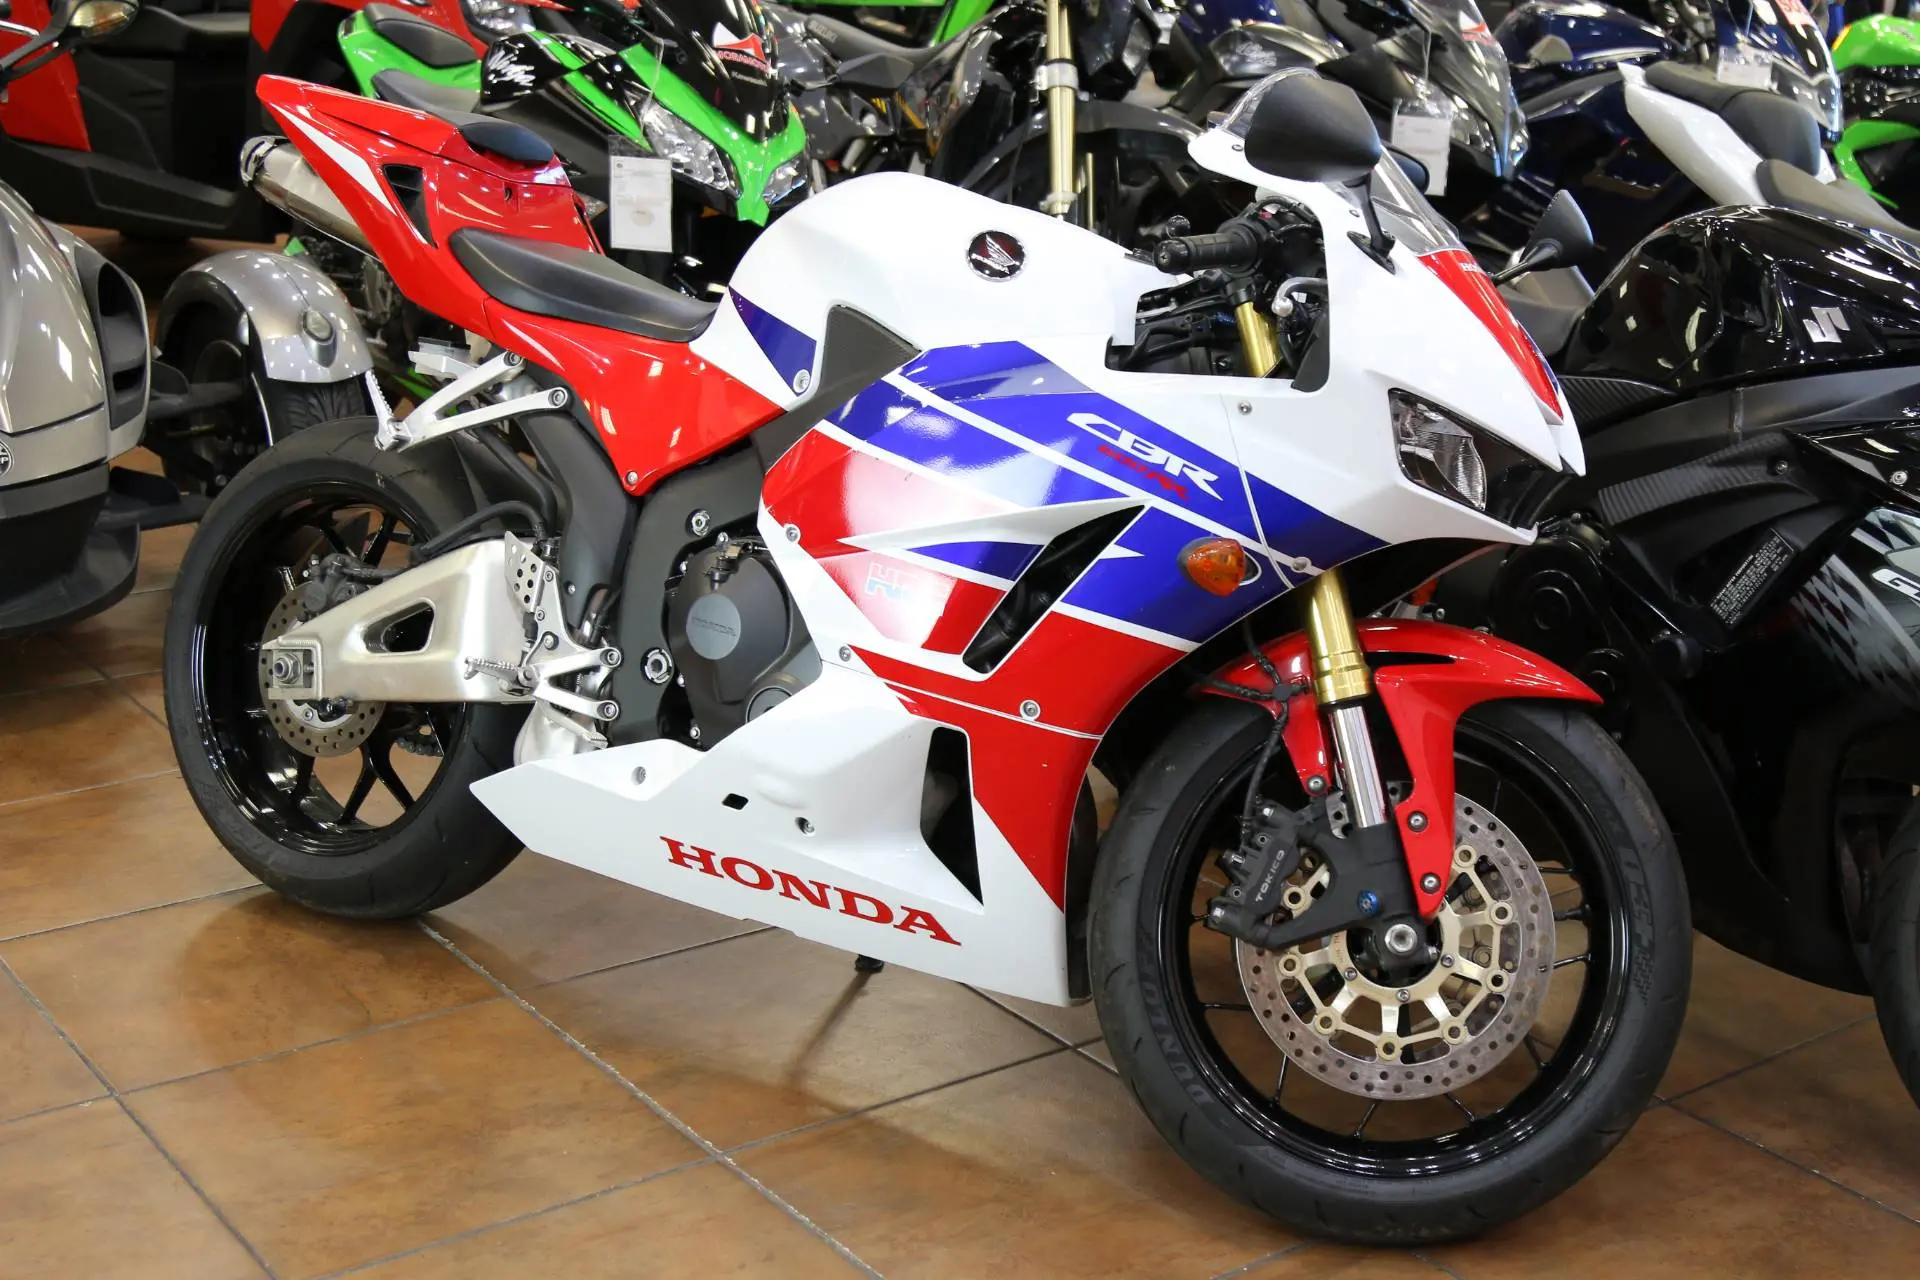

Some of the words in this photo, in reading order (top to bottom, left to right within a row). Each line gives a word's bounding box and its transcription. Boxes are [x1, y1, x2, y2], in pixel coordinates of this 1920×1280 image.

[1066, 412, 1224, 502] CBR
[660, 836, 962, 947] HONDA
[1255, 848, 1286, 903] TOKICO
